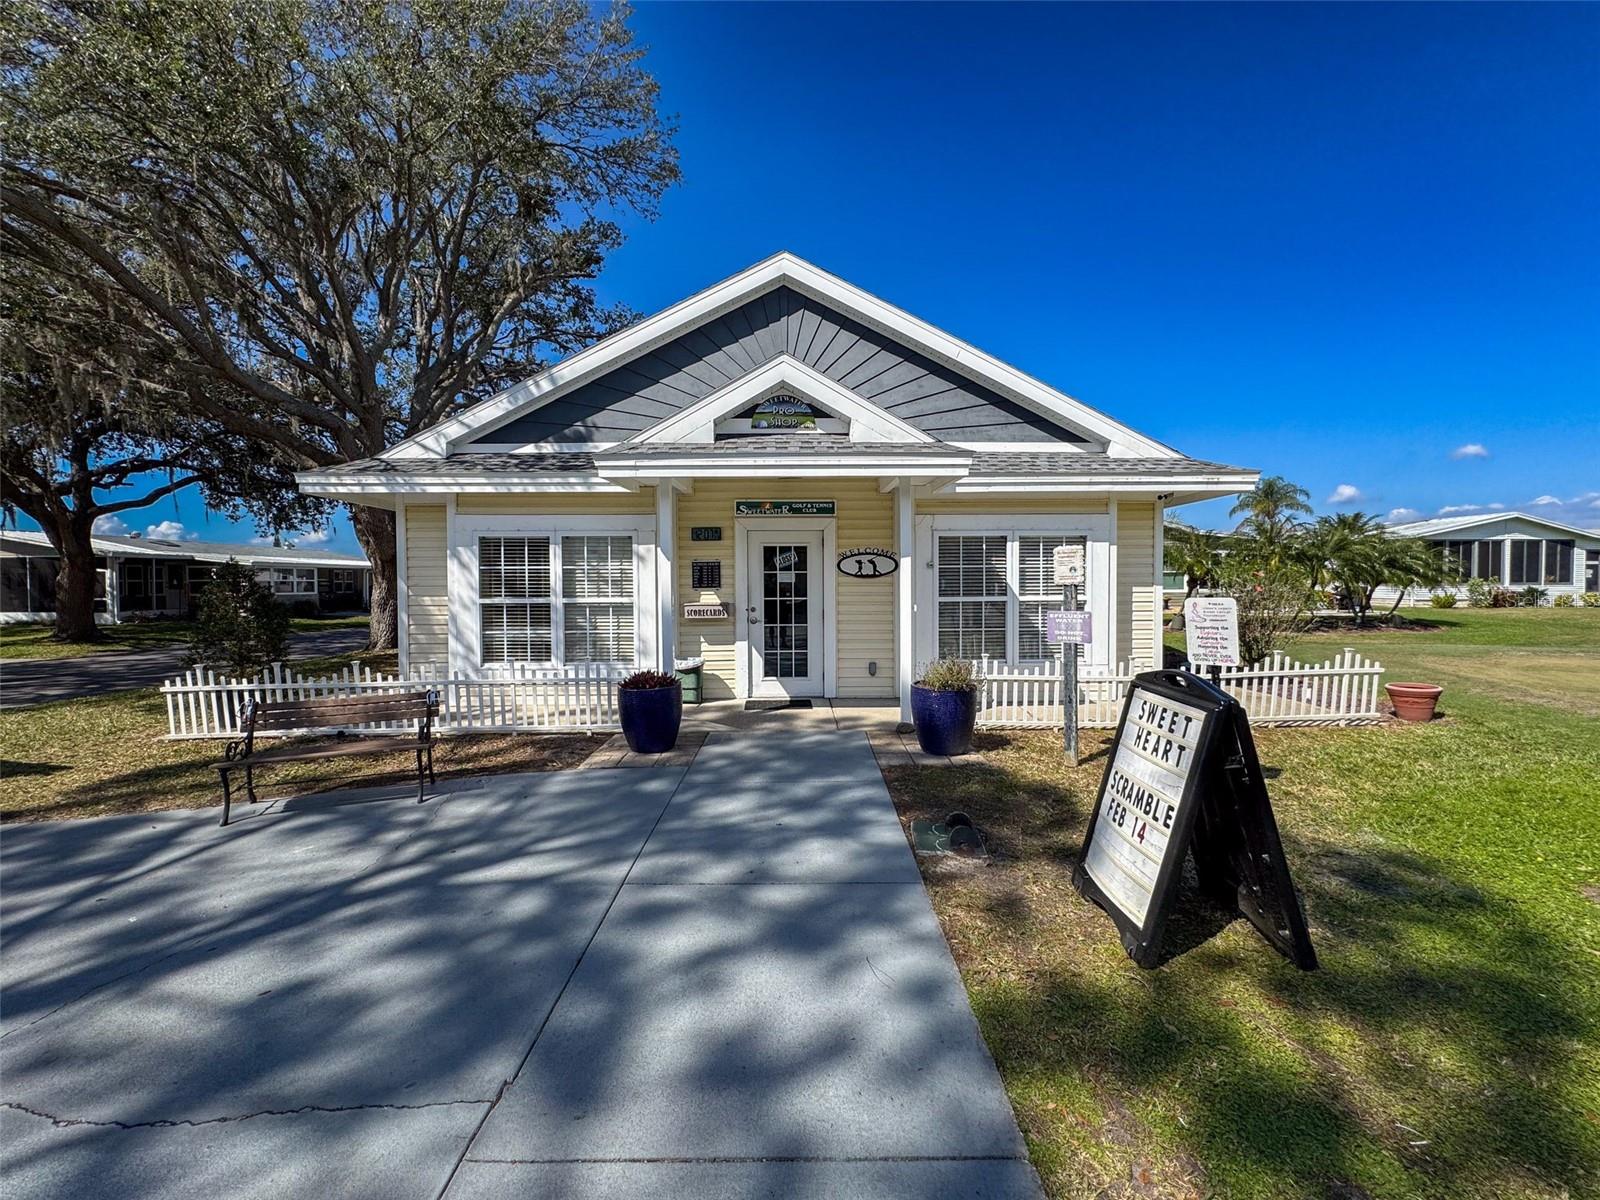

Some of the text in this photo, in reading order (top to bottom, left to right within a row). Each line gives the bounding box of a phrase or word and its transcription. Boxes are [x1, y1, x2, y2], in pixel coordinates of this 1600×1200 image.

[770, 416, 798, 427] SHOP
[772, 405, 795, 415] PRO
[839, 547, 898, 558] WELCOME
[686, 606, 726, 617] SCORECARDS
[1138, 700, 1193, 739] SWEET
[1133, 726, 1186, 768] HEART
[1110, 770, 1175, 829] SCRAMBLE
[1106, 797, 1147, 844] FEB 14
